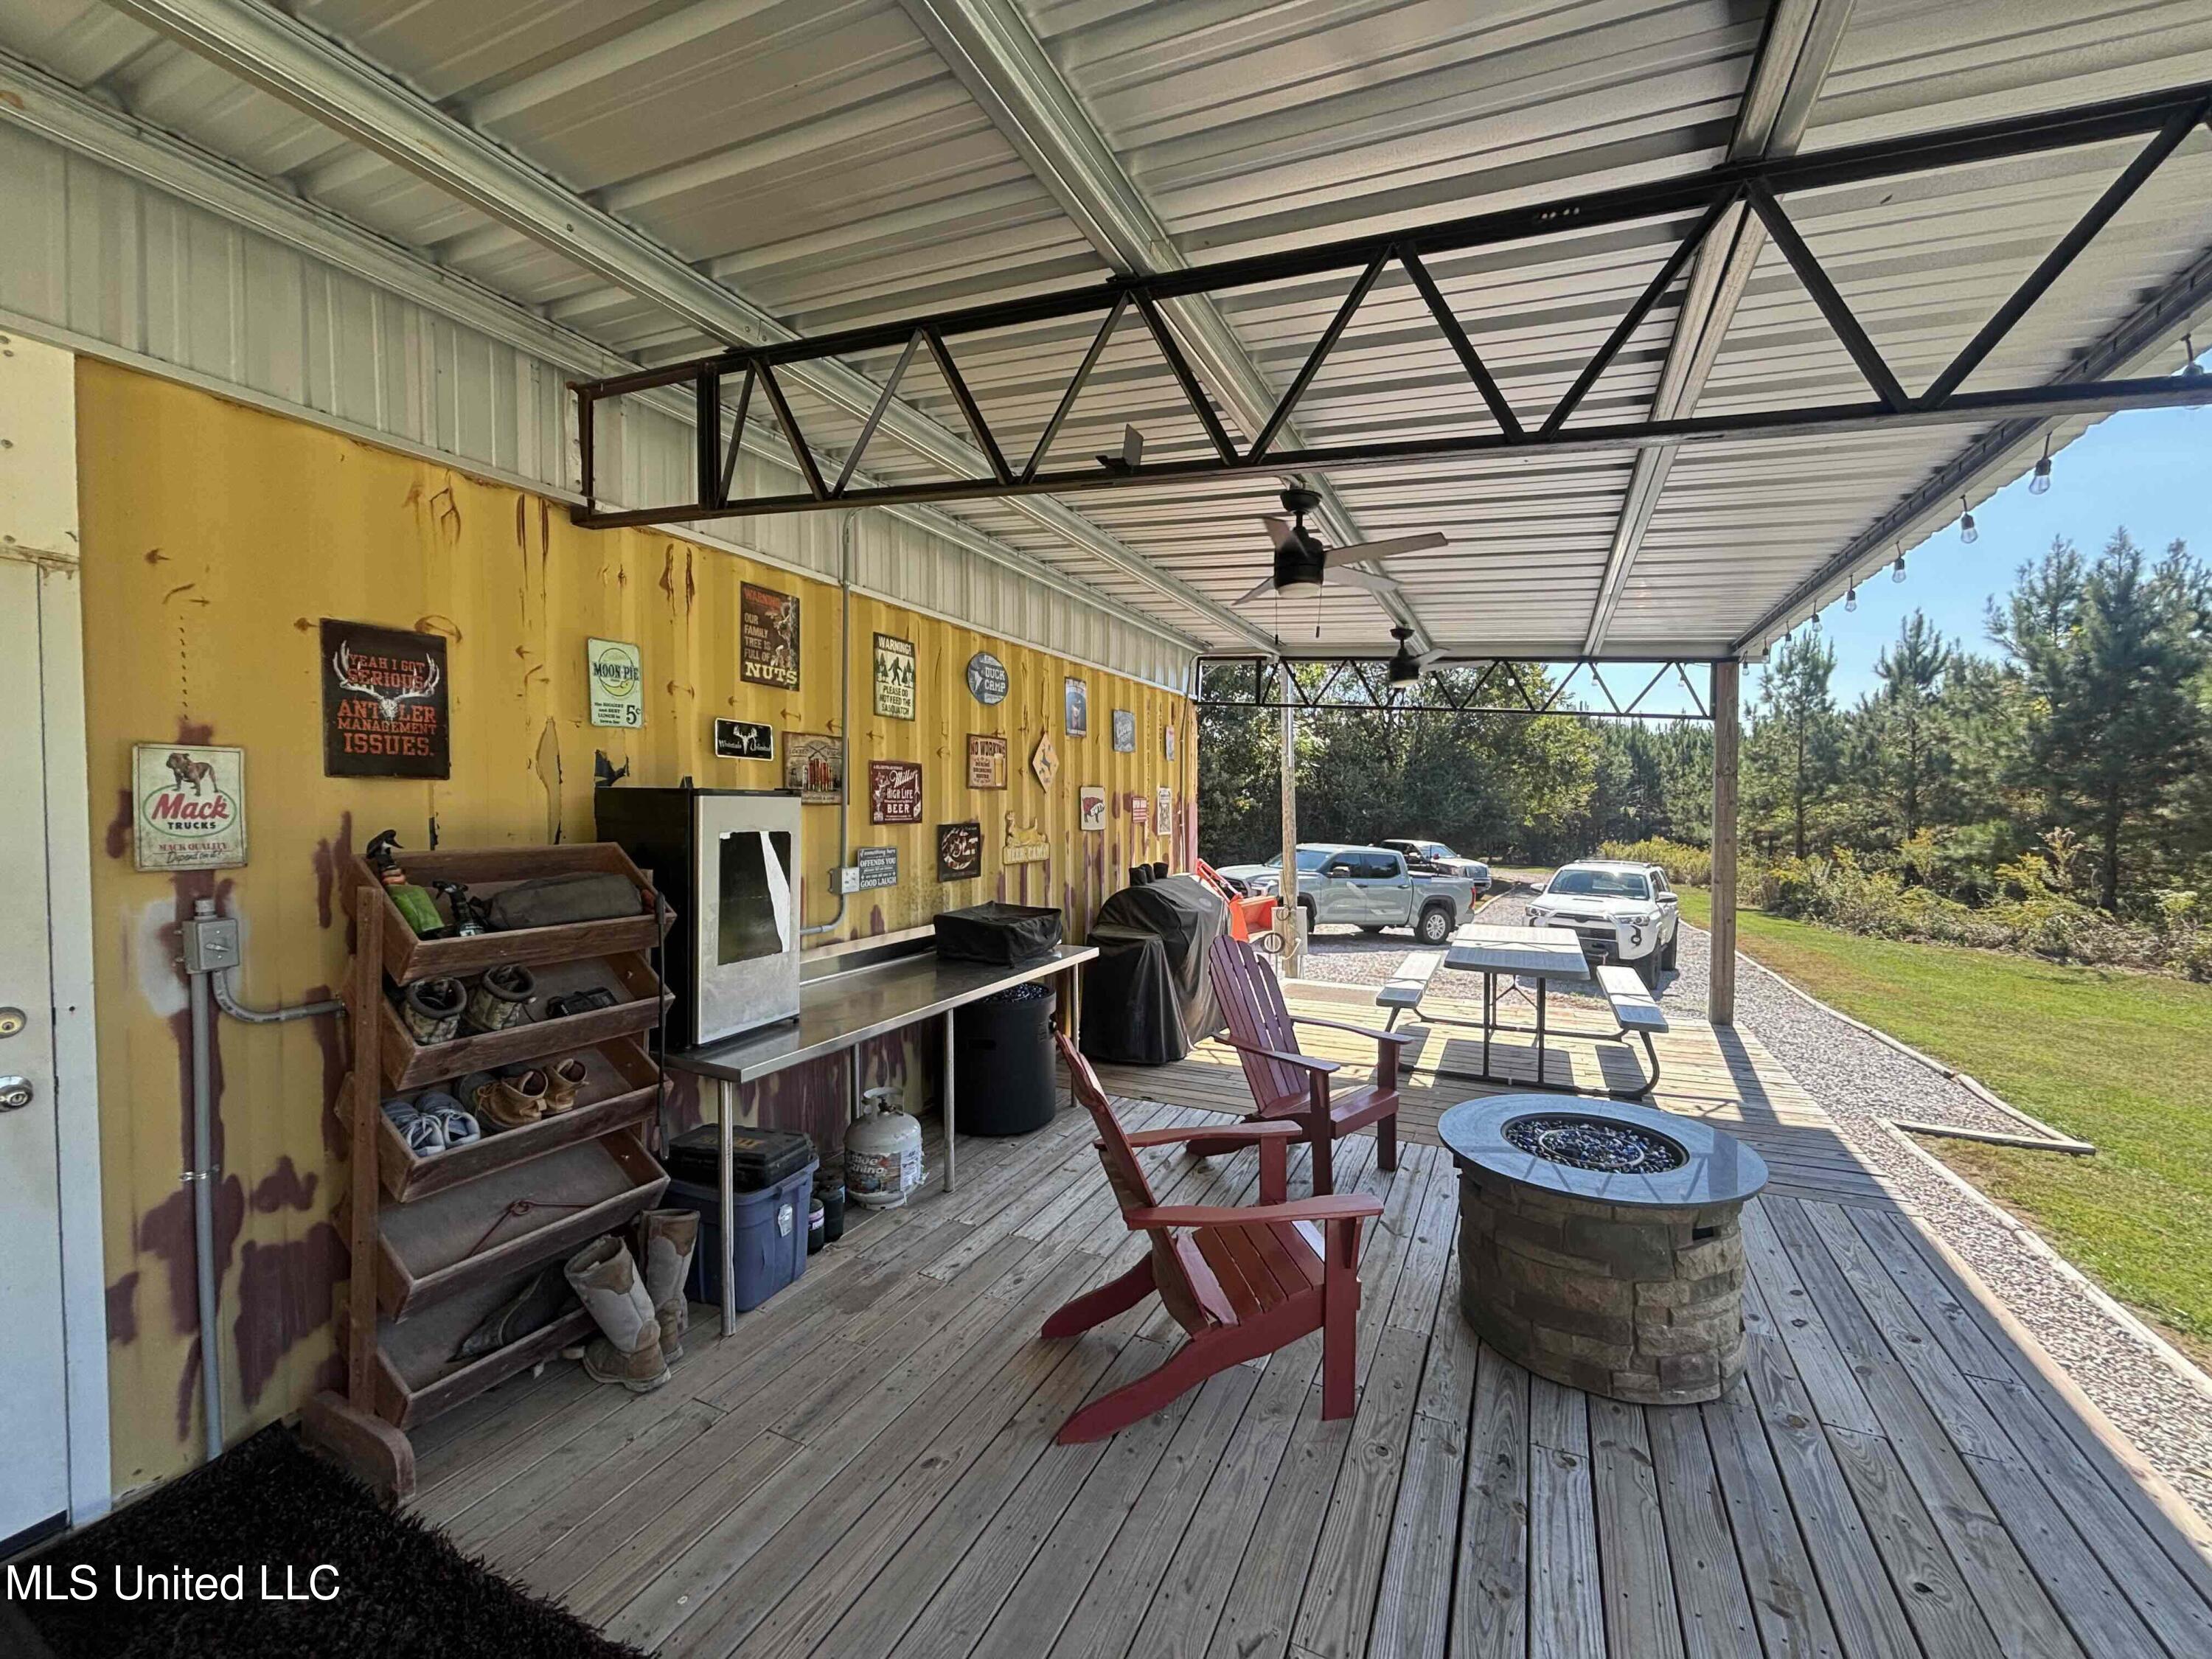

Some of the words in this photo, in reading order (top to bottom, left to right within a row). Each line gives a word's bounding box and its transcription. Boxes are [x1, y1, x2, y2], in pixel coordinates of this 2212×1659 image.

[744, 613, 759, 625] OUR
[744, 625, 768, 638] FAMILY
[744, 636, 762, 649] TREE
[764, 640, 771, 650] IS
[877, 636, 912, 655] WARNING!
[744, 648, 760, 661] FULL
[762, 652, 771, 662] OF
[349, 653, 388, 669] YEAH
[392, 659, 397, 669] I
[401, 661, 425, 672] GOT
[593, 662, 620, 679] MOON
[624, 665, 640, 681] PIE
[745, 661, 797, 684] NUTS
[985, 667, 1006, 681] DUCK
[347, 667, 425, 690] SERIOUS
[883, 685, 901, 697] PLEASE
[902, 689, 908, 698] DO
[984, 679, 1006, 692] CAMP
[880, 694, 889, 703] NOT
[889, 695, 902, 706] FEED
[902, 698, 911, 707] THE
[881, 703, 910, 714] SASQUATCH
[337, 717, 437, 734] MANAGEMENT
[344, 733, 434, 757] ISSUES.
[970, 741, 978, 756] NO
[980, 741, 1006, 759] WORKING
[889, 769, 918, 788] Miller
[886, 787, 900, 799] HIGH
[902, 787, 914, 799] LIFE
[151, 793, 229, 820] Mack
[887, 804, 910, 814] BEER
[167, 821, 216, 830] TRUCKS
[159, 843, 186, 851] MACK
[188, 842, 227, 851] QUALITY
[166, 851, 198, 864] Depend
[860, 859, 885, 867] OFFENDS
[860, 879, 877, 888] GOOD
[877, 877, 897, 886] LAUGH
